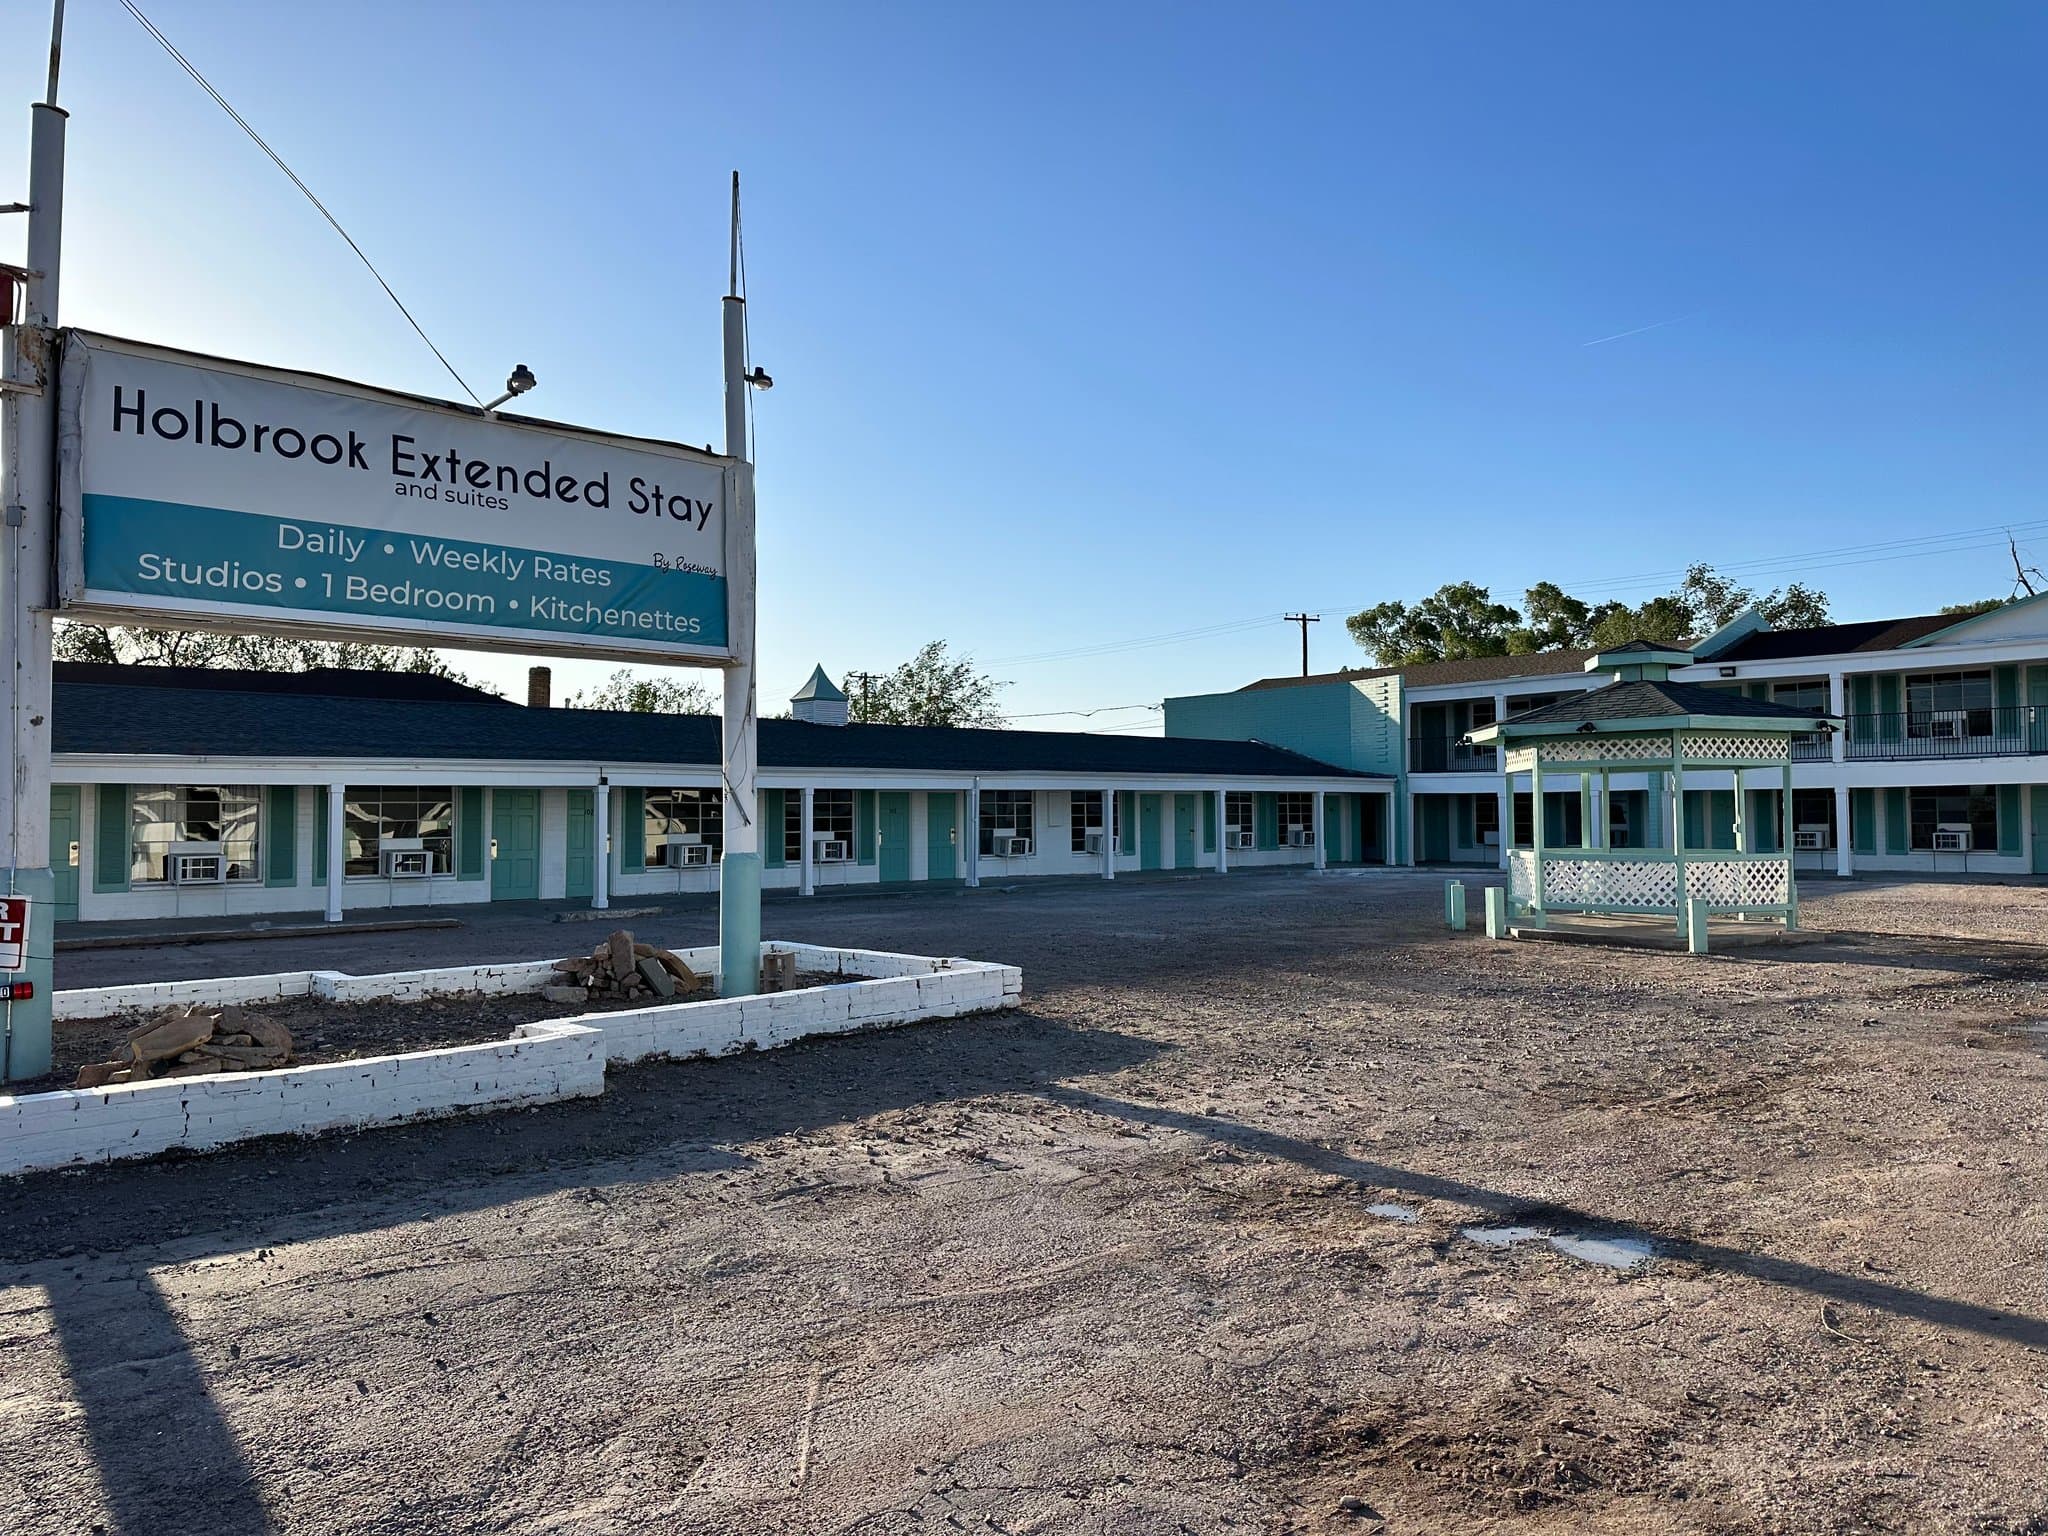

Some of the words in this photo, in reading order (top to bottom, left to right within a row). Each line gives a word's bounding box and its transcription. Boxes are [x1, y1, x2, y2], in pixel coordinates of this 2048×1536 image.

[113, 385, 370, 471] Holbrook
[391, 433, 610, 509] Extended
[628, 476, 713, 532] Stay
[395, 482, 438, 501] and
[444, 488, 509, 511] suites
[278, 523, 366, 563] Daily
[409, 539, 525, 581] Weekly
[533, 555, 613, 587] Rates
[652, 552, 670, 574] By
[675, 555, 719, 581] Roseway
[137, 553, 283, 593] Studios
[321, 572, 332, 598] 1
[345, 574, 496, 614] Bedroom
[530, 595, 701, 634] Kitchenettes
